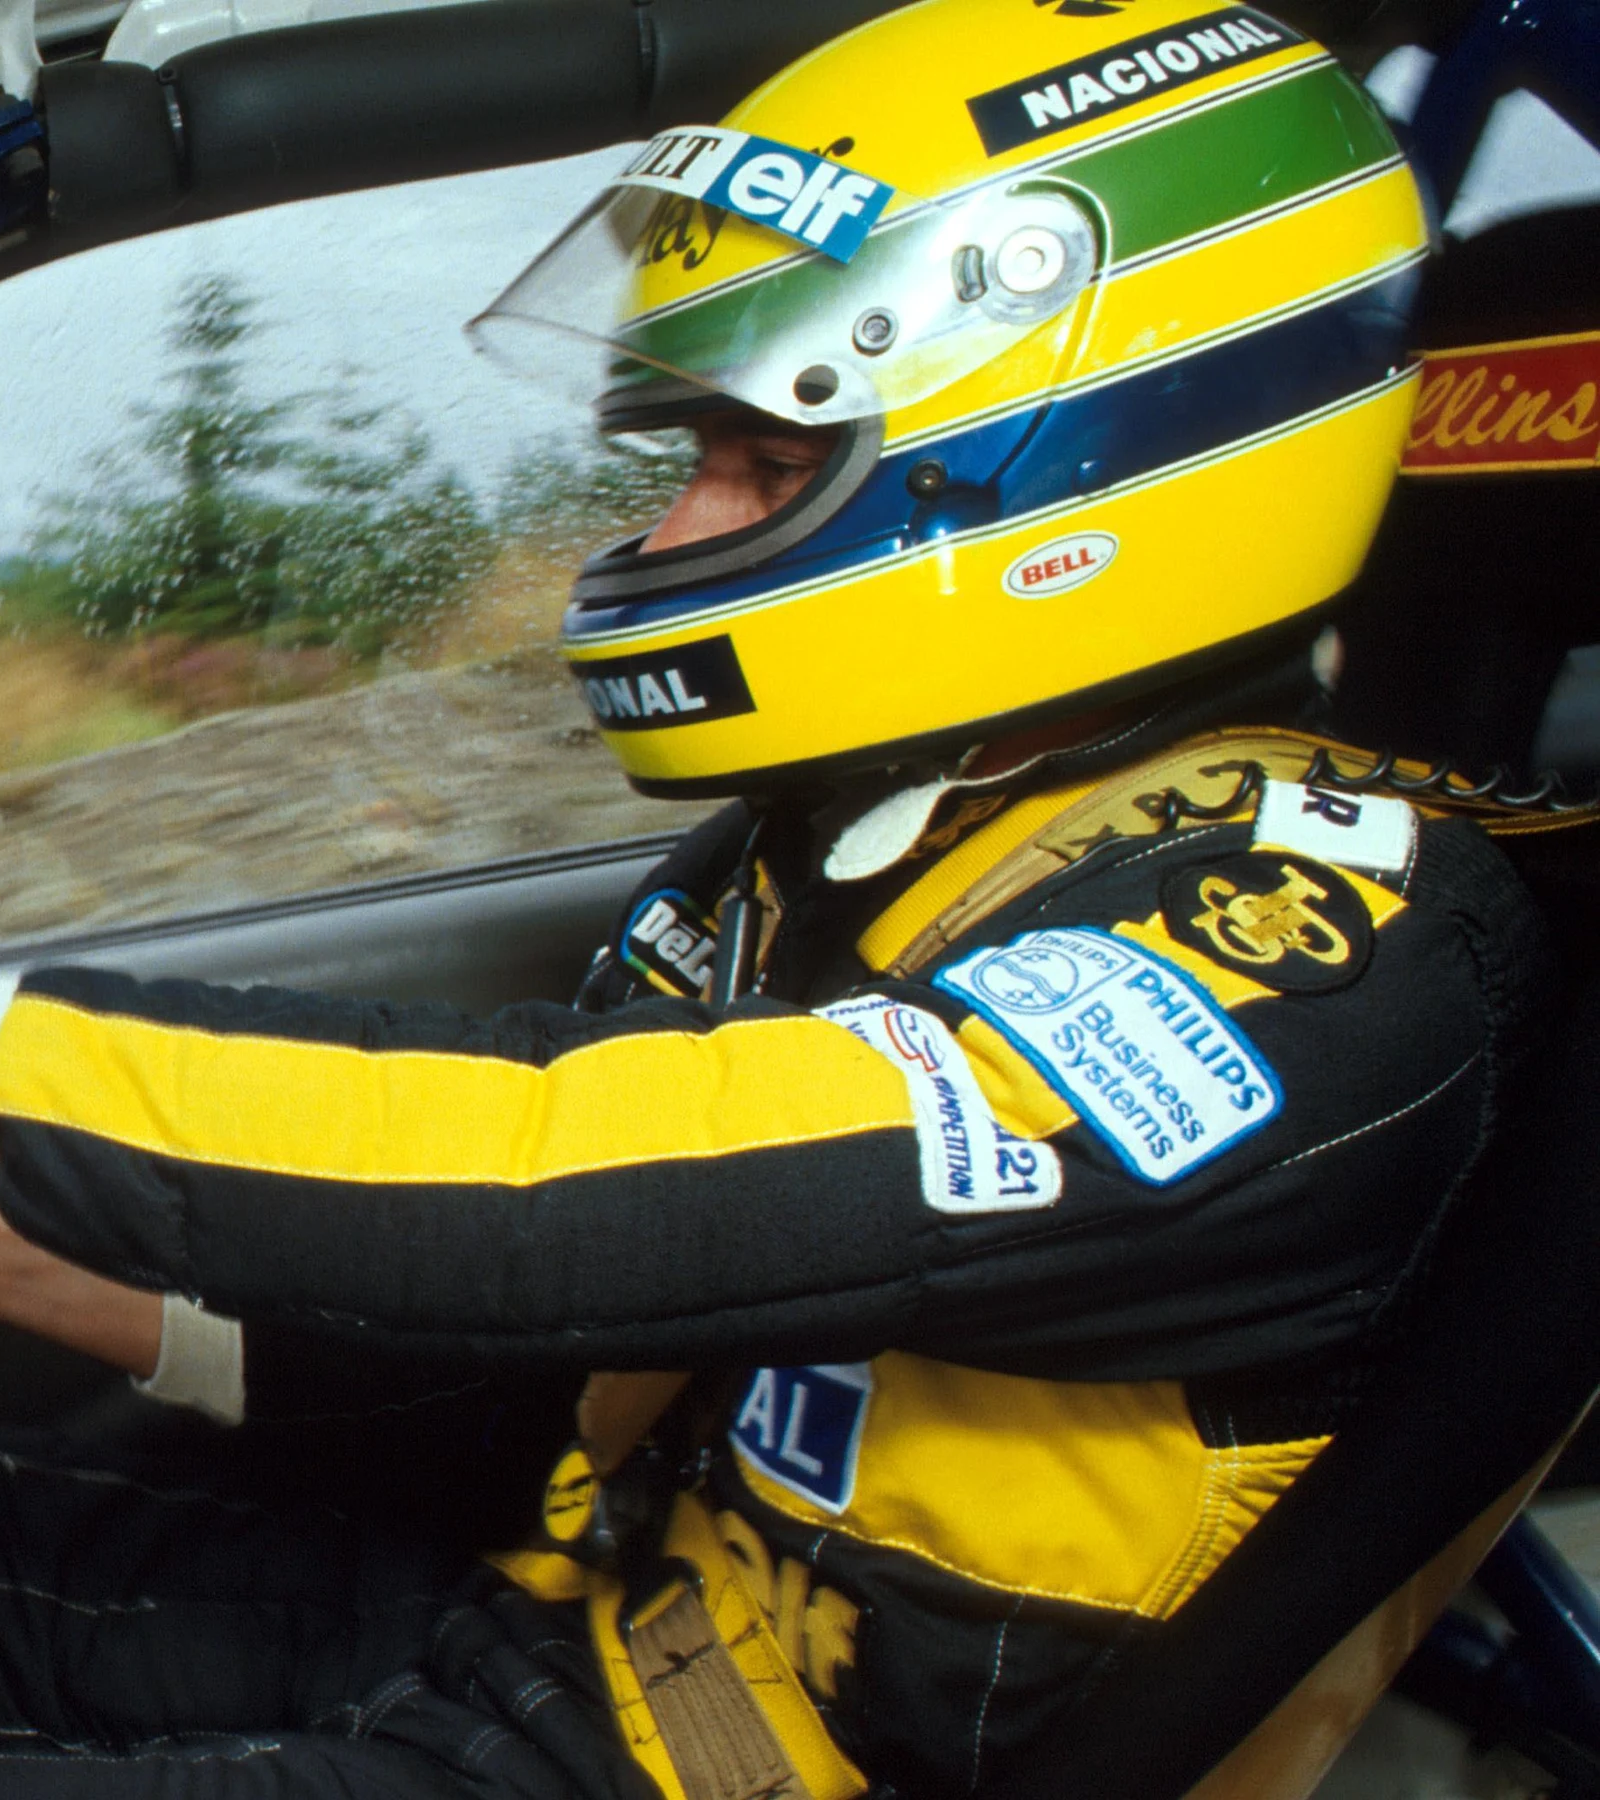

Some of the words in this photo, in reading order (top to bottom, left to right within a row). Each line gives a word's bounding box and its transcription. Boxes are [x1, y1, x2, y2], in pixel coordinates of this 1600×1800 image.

[1021, 17, 1282, 129] NACIONAL
[728, 152, 877, 245] elf
[1021, 547, 1097, 587] BELL
[1037, 933, 1118, 970] PHILIPS
[1051, 1022, 1174, 1160] Systems
[1076, 1000, 1206, 1144] Business
[1125, 966, 1266, 1112] PHILIPS
